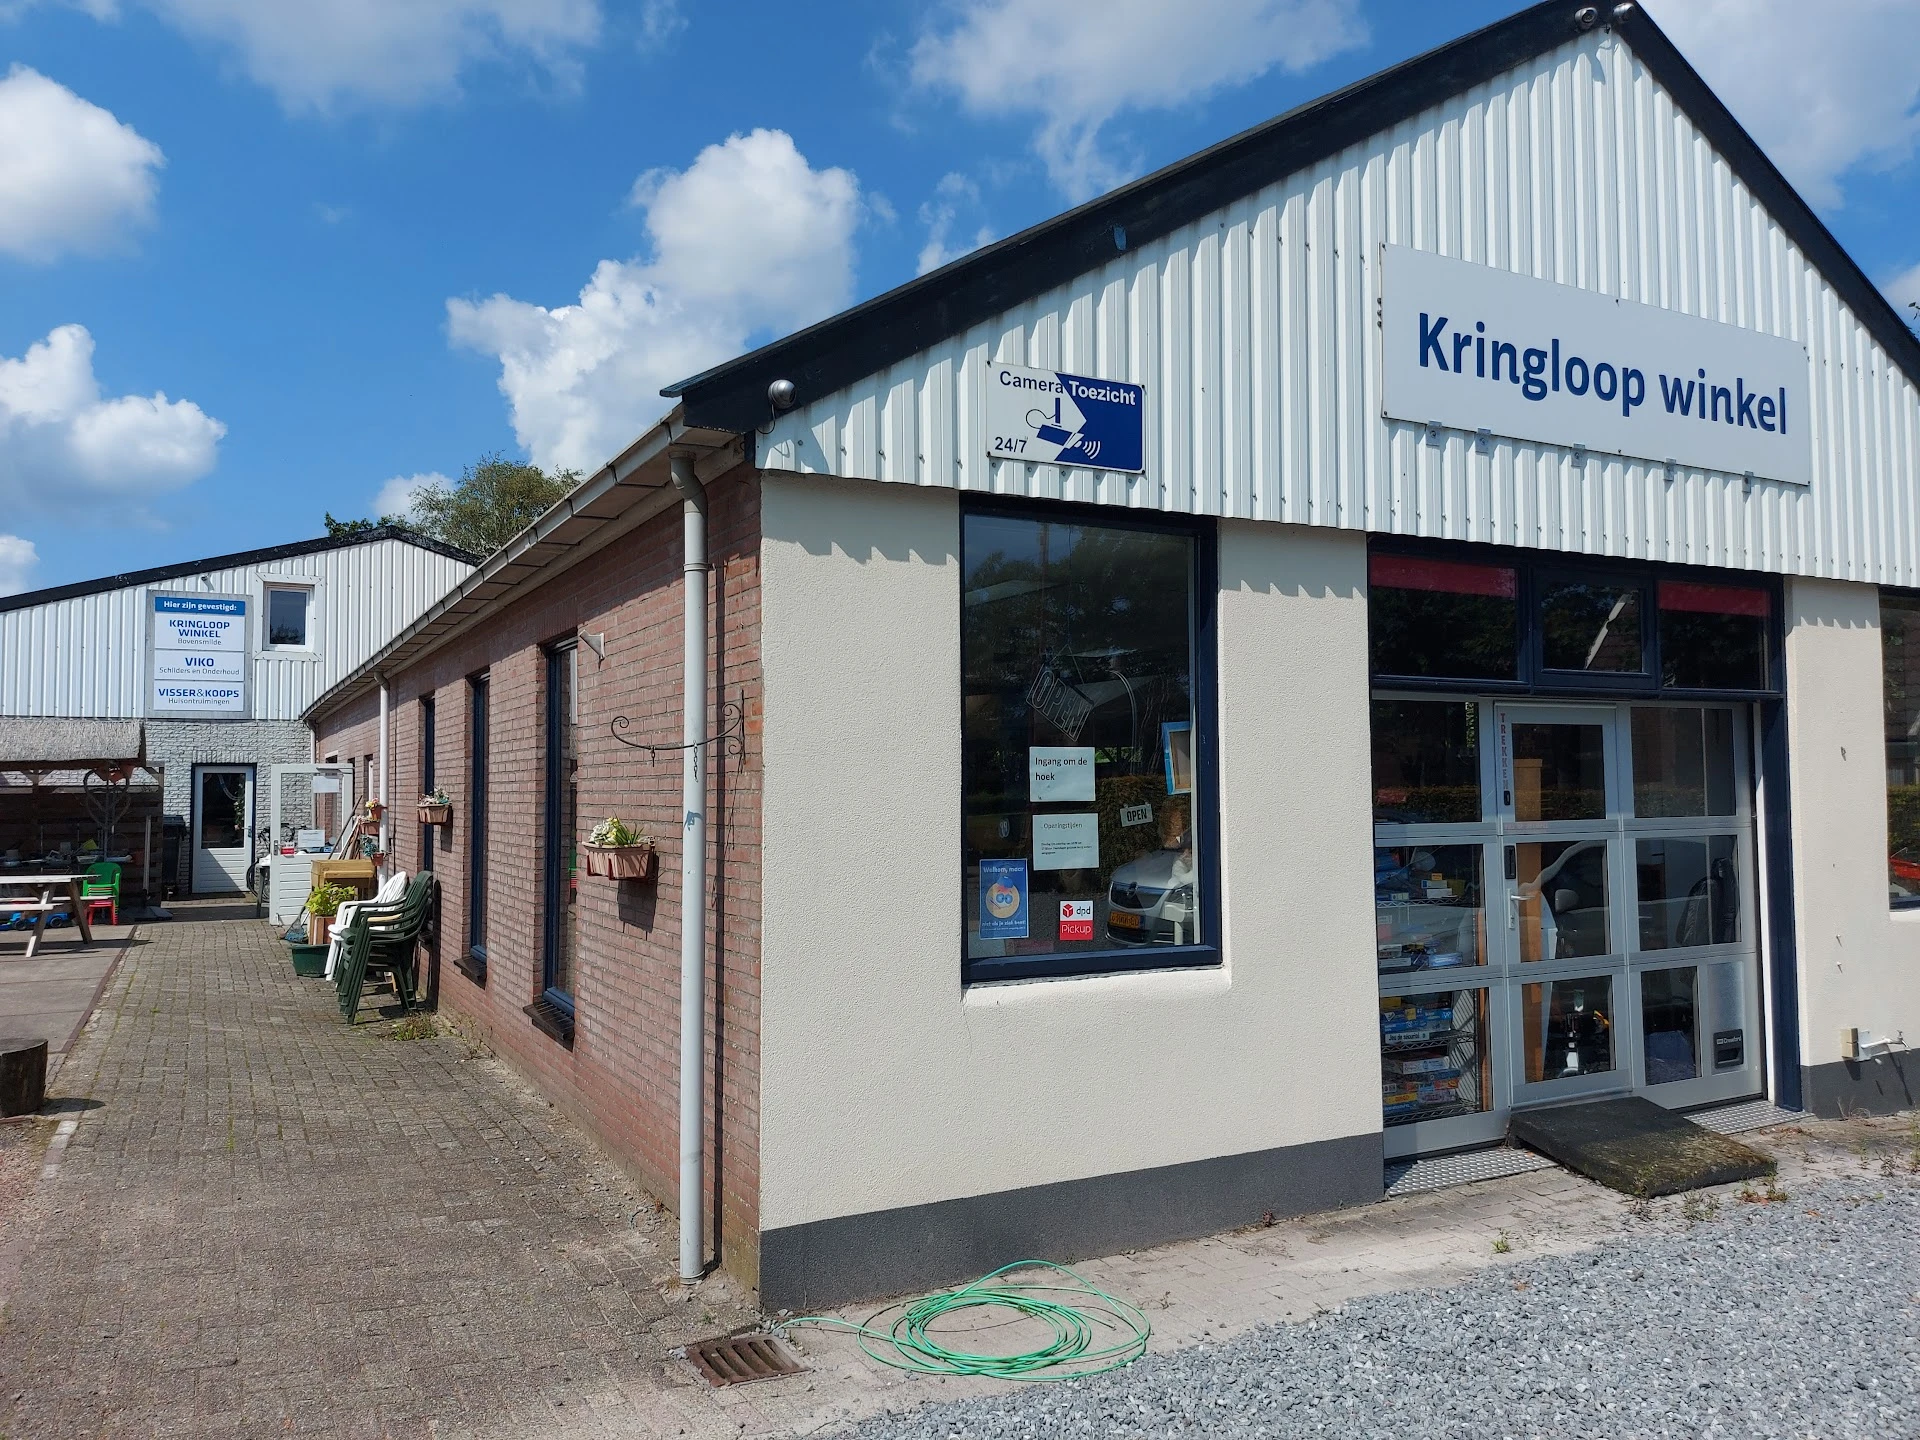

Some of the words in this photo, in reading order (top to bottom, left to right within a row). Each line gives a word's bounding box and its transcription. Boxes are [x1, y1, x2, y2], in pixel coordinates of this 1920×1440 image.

[1418, 312, 1646, 418] Kringloop
[1658, 368, 1788, 435] winkel
[999, 370, 1064, 394] Camera
[1068, 380, 1136, 406] Toezicht
[994, 436, 1028, 453] 24/7
[163, 600, 181, 608] Hier
[182, 601, 196, 610] zijn
[197, 603, 237, 612] gevestigd:
[169, 619, 230, 630] KRINGLOOP
[178, 628, 221, 638] WINKEL
[177, 638, 222, 646] Bovensmilde
[185, 657, 215, 667] VIKO
[158, 688, 240, 698] VISSER&KOOPS
[168, 697, 230, 706] Huisontruimingen
[1031, 669, 1088, 739] OPEN
[1499, 712, 1509, 790] TREKKEN
[1035, 757, 1062, 767] Ingang
[1077, 756, 1088, 766] de
[1035, 772, 1055, 781] hoek
[1126, 808, 1148, 822] OPEN
[1076, 905, 1091, 917] dpd
[1061, 923, 1092, 935] Pickup
